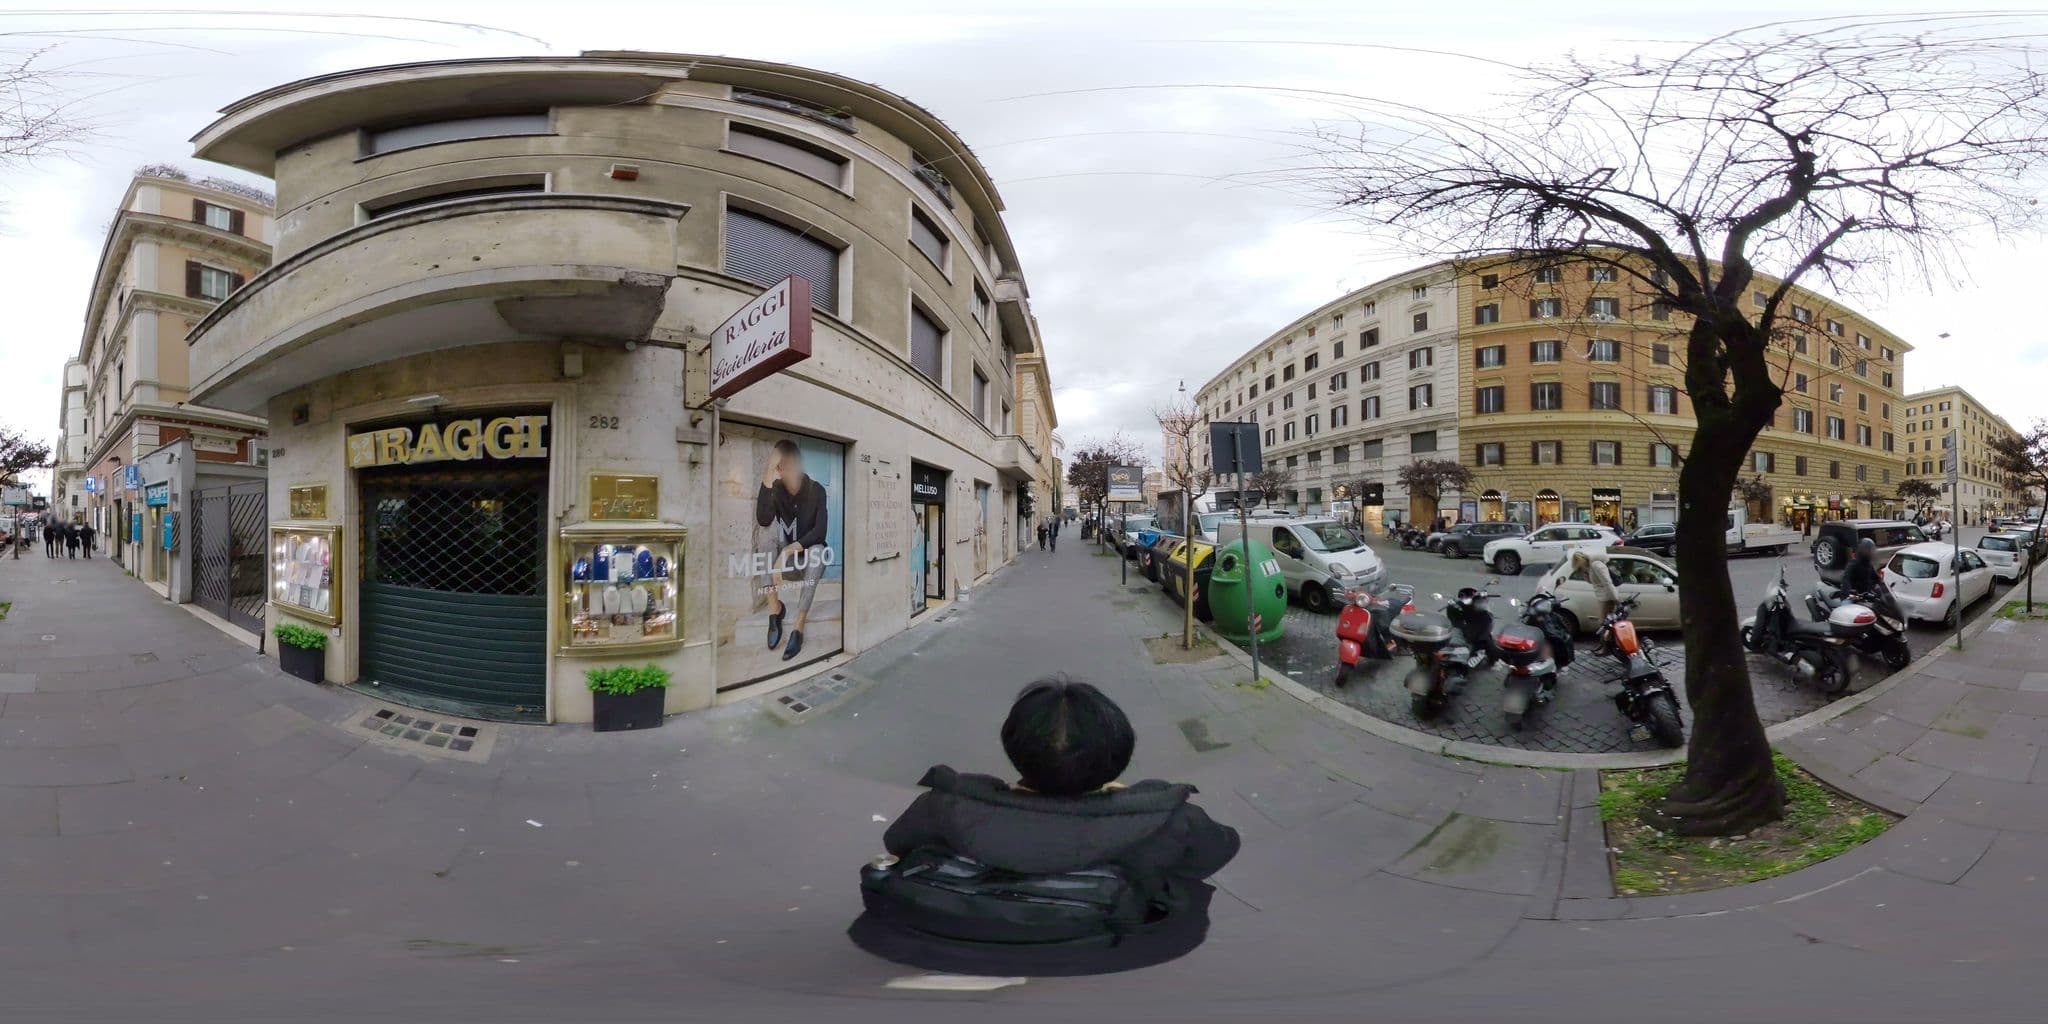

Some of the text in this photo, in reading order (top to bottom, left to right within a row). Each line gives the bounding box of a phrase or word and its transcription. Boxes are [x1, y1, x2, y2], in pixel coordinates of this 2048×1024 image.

[725, 288, 786, 345] RAGGI
[711, 329, 786, 386] Gioielleria
[589, 415, 619, 430] 282
[376, 415, 548, 465] RAGGI
[272, 447, 286, 459] 280
[913, 483, 938, 496] MELLUSO
[599, 498, 649, 513] RAGGI
[779, 516, 799, 542] M
[728, 546, 835, 578] MELLUSO
[757, 579, 815, 595] NEXT OPENING
